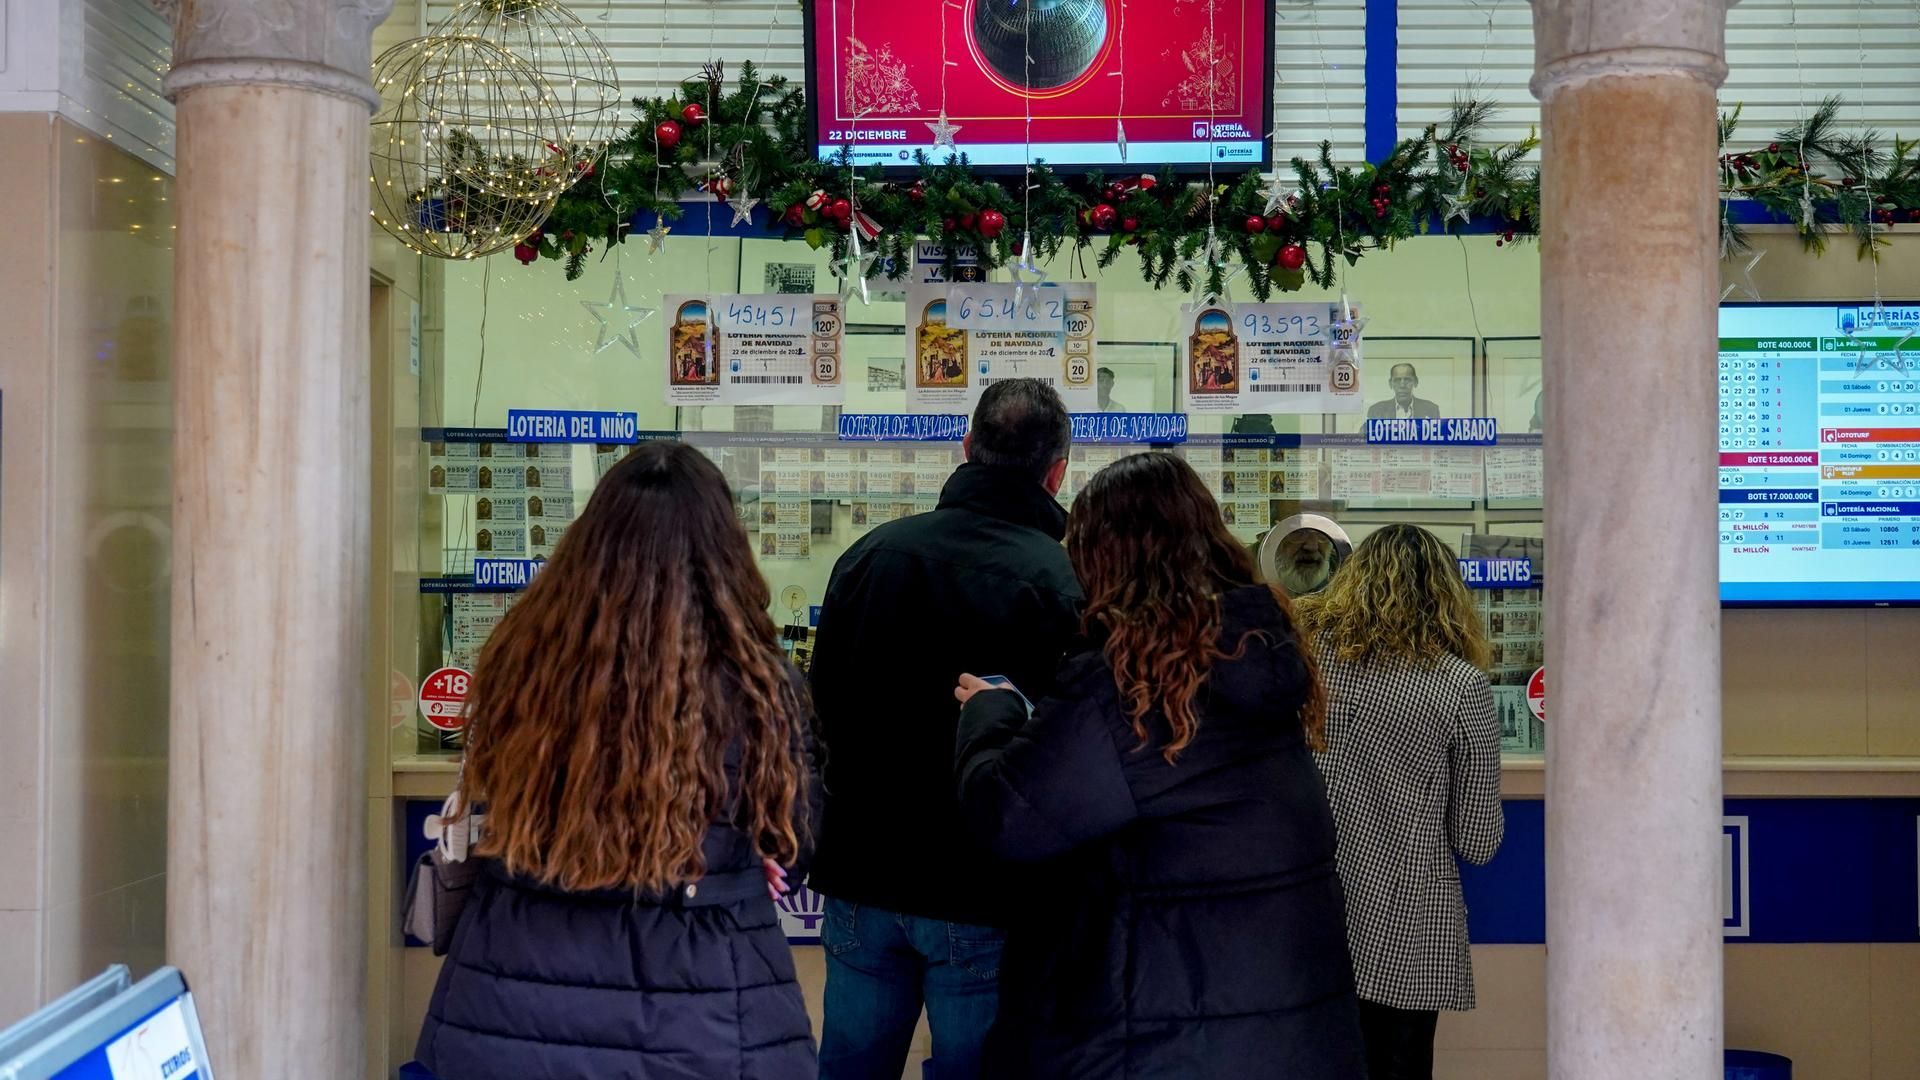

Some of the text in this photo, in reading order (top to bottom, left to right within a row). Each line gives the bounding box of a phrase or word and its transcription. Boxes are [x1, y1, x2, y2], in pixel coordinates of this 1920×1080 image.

[828, 130, 906, 140] 22 DICIEMBRE
[1210, 122, 1243, 131] LOTERÍA
[729, 303, 796, 327] 45.451
[1244, 313, 1321, 336] 93.593
[820, 364, 832, 373] 20
[1072, 366, 1084, 375] 20
[1338, 372, 1349, 381] 20
[510, 412, 634, 438] LOTERIA DEL NIÑO
[839, 414, 968, 441] LOTERIA DE NAVIDAD
[1110, 416, 1128, 438] DE
[1130, 414, 1187, 440] NAVIDAD
[1369, 419, 1495, 441] LOTERIA DEL SABADO
[476, 562, 526, 585] LOTERIA
[1460, 560, 1530, 581] DEL JUEVES
[434, 674, 468, 695] +18
